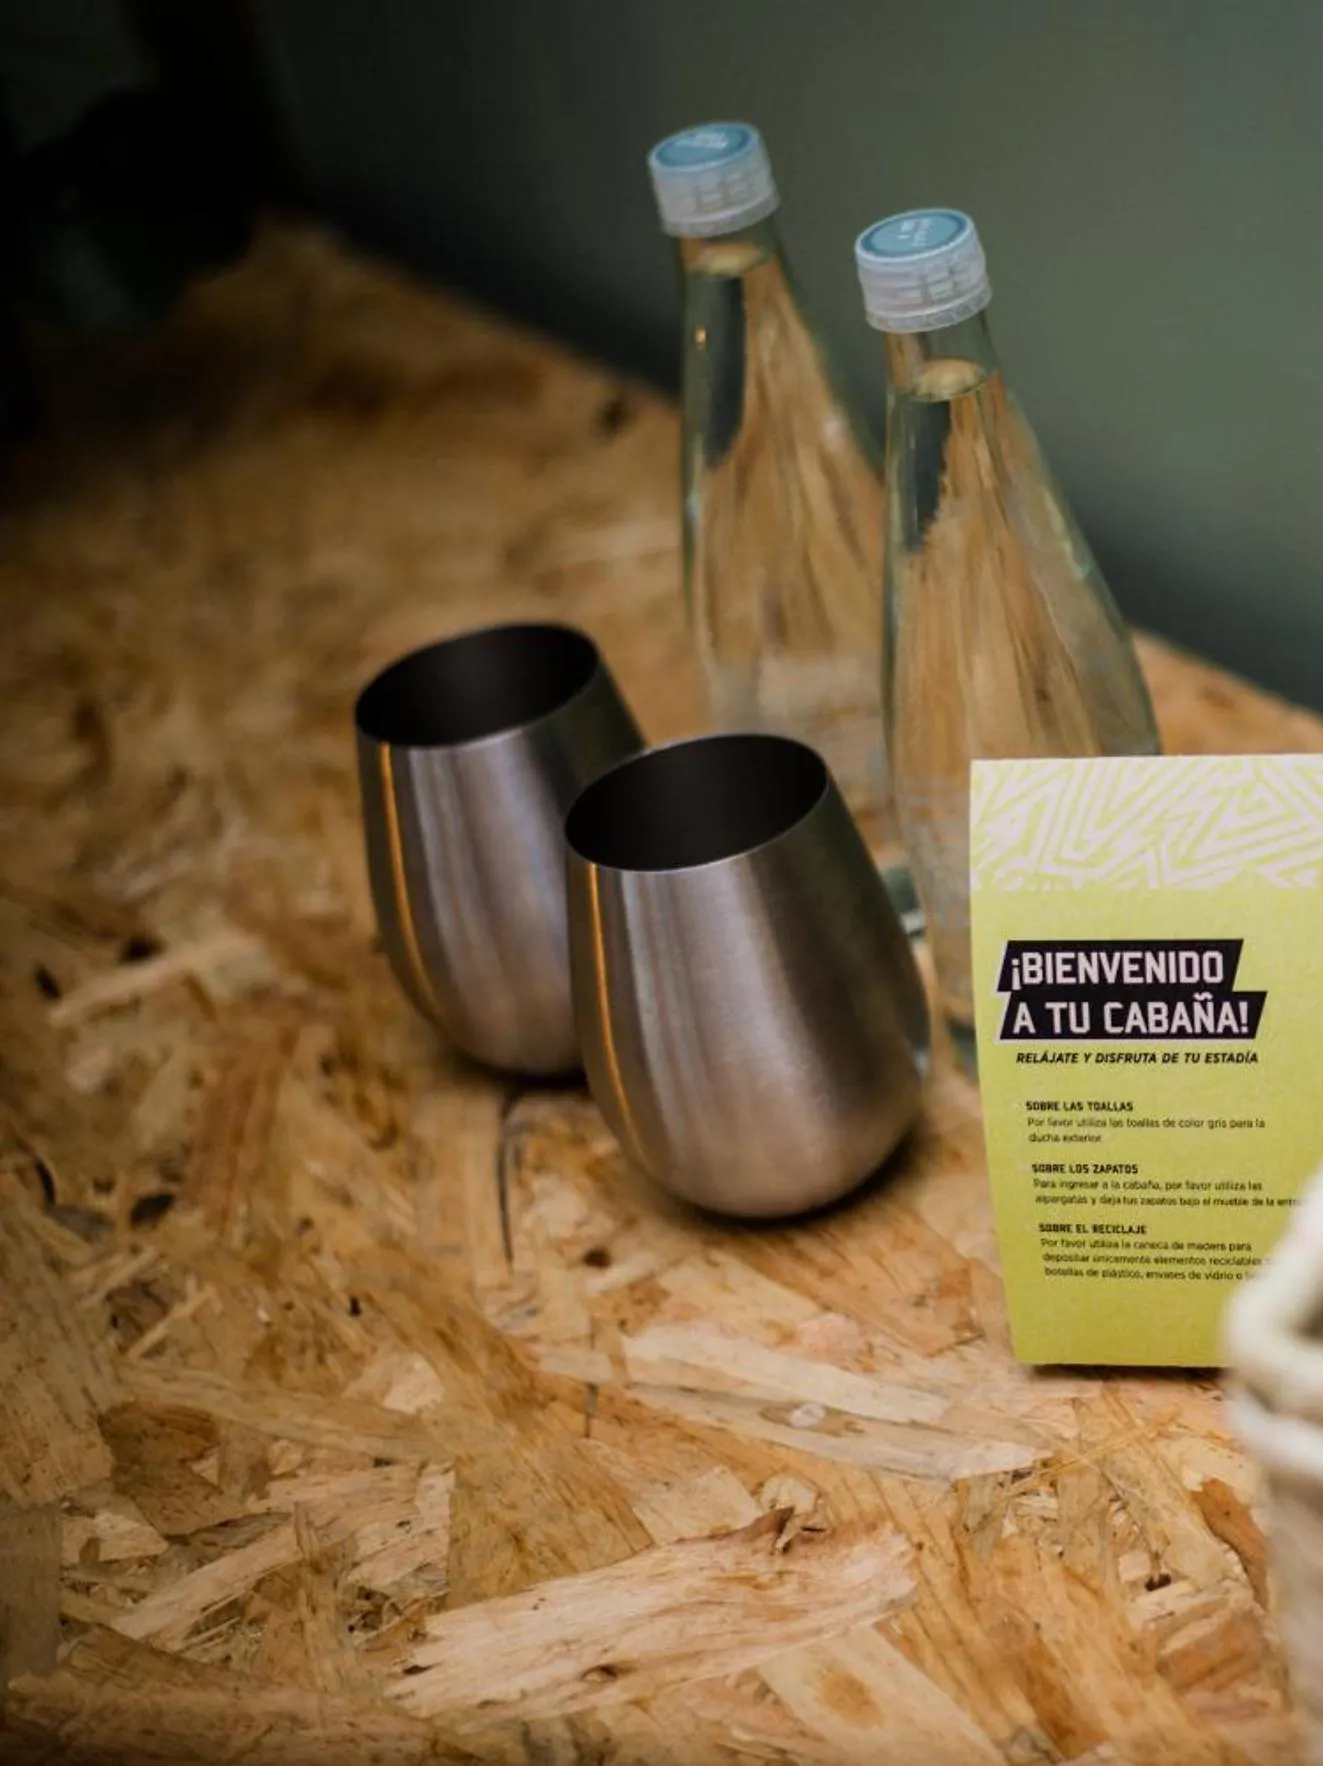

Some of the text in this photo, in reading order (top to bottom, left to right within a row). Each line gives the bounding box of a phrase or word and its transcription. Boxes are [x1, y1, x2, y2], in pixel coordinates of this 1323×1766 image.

[1011, 950, 1224, 991] ¡BIENVENIDO
[1012, 991, 1249, 1034] A TU CABAÑA!
[1016, 1050, 1259, 1064] RELÁJATE Y DISFRUTA DE TU ESTADÍA
[1026, 1100, 1134, 1112] SOBRE LAS TOALLAS
[1162, 1118, 1176, 1128] de
[1178, 1118, 1205, 1128] color
[1207, 1119, 1228, 1130] gris
[1032, 1163, 1139, 1175] SOBRE LOS ZAPATOS
[1039, 1223, 1147, 1235] SOBRE EL RECICLAJE
